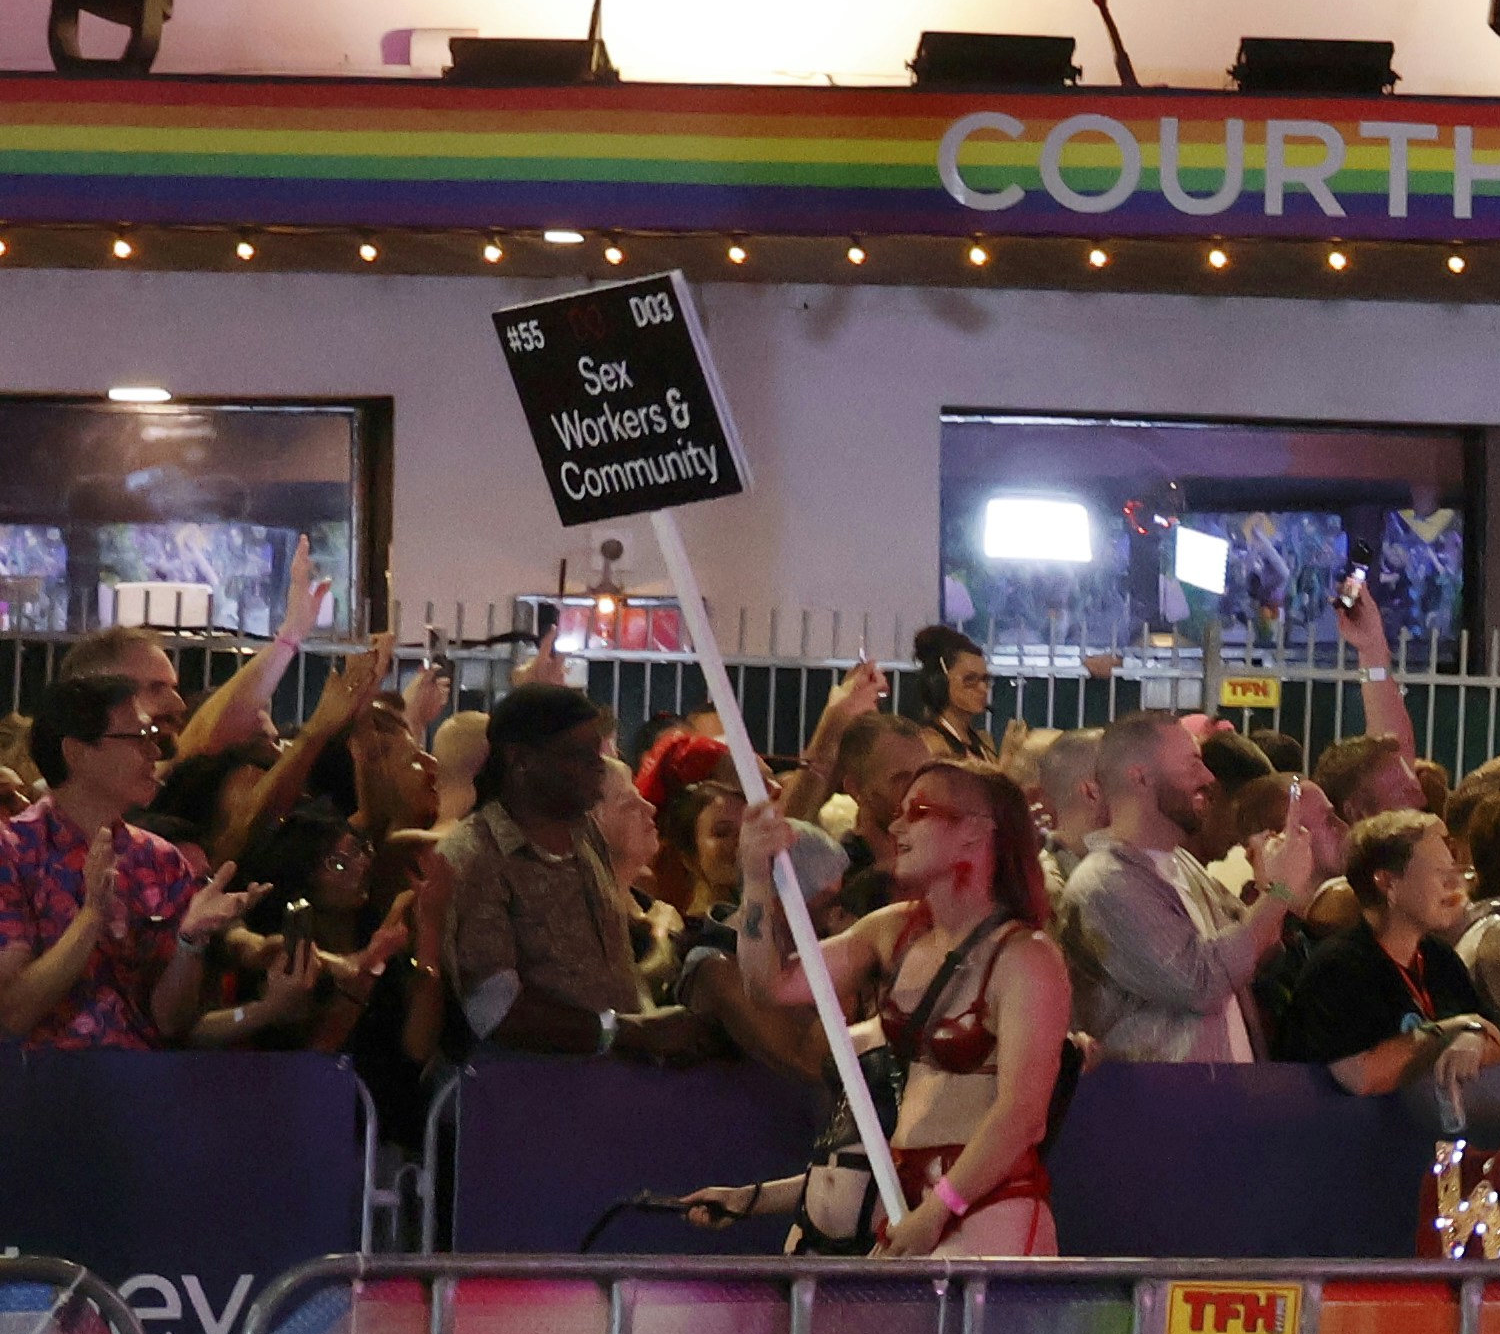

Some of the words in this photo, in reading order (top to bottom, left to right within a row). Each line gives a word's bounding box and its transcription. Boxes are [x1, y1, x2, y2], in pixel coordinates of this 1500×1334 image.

[628, 291, 675, 329] D03
[507, 320, 545, 353] #55
[577, 354, 634, 396] Sex
[551, 401, 668, 452] Workers
[665, 386, 691, 430] &
[560, 437, 719, 501] Community
[1183, 1290, 1279, 1334] TFH
